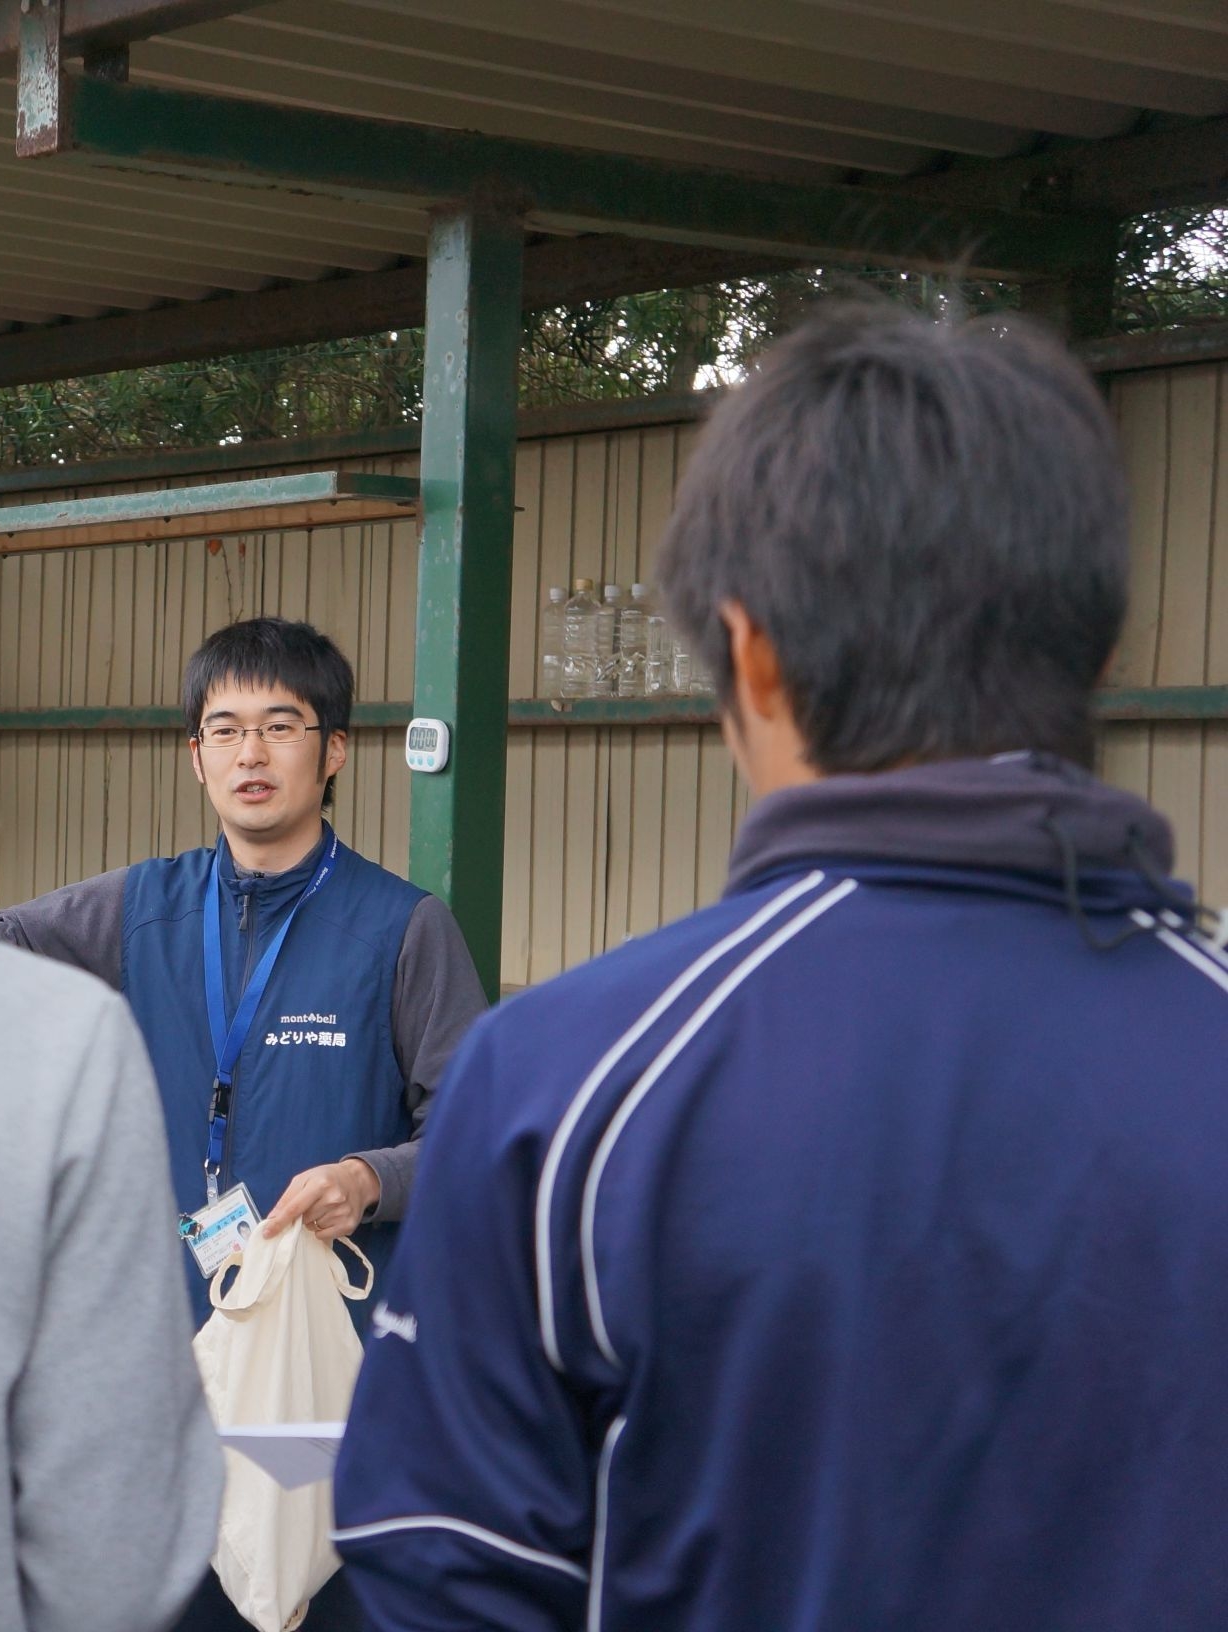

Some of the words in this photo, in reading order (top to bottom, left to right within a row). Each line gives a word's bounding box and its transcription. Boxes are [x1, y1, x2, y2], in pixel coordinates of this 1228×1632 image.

[265, 1030, 347, 1047] みどりや薬局
